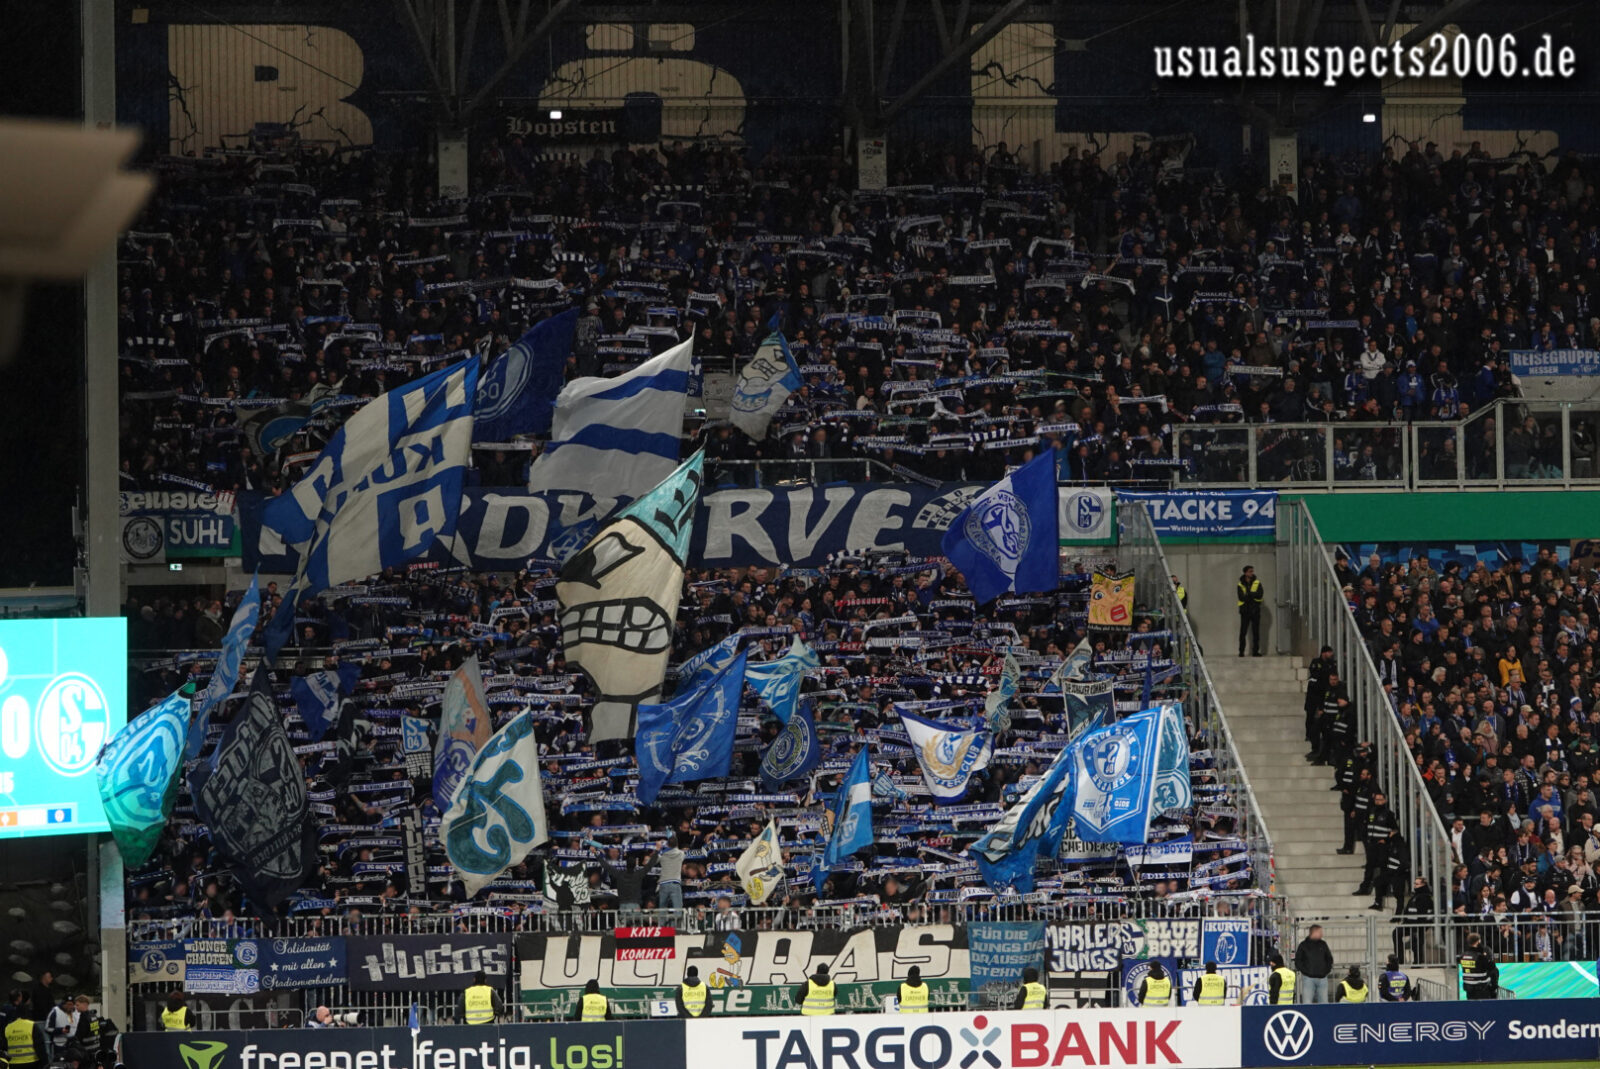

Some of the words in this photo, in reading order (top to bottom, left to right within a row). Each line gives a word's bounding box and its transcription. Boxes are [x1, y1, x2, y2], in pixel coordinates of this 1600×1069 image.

[506, 116, 616, 137] Hopsten
[1513, 350, 1600, 366] REISEGRUPPE
[1242, 498, 1275, 519] 94
[169, 519, 230, 545] SUHL
[2, 695, 31, 759] 0
[566, 757, 627, 771] NORDKURVE
[630, 927, 662, 938] КЛУБ
[972, 926, 1002, 941] FÜR
[1147, 921, 1199, 939] BLUE
[192, 940, 227, 954] JUNGE
[273, 938, 331, 959] Solidarität
[620, 948, 673, 961] КОМИТИ
[972, 942, 1020, 954] JUNGS
[1147, 939, 1198, 957] BOYZ
[185, 953, 233, 966] CHAOTEN
[281, 961, 298, 973] mit
[300, 961, 325, 971] allen
[361, 942, 506, 982] HUGOS
[1050, 949, 1120, 972] JUNGS
[658, 1001, 669, 1014] 5
[1011, 1020, 1184, 1068] BANK
[1333, 1020, 1496, 1051] ENERGY
[550, 1035, 623, 1069] los!
